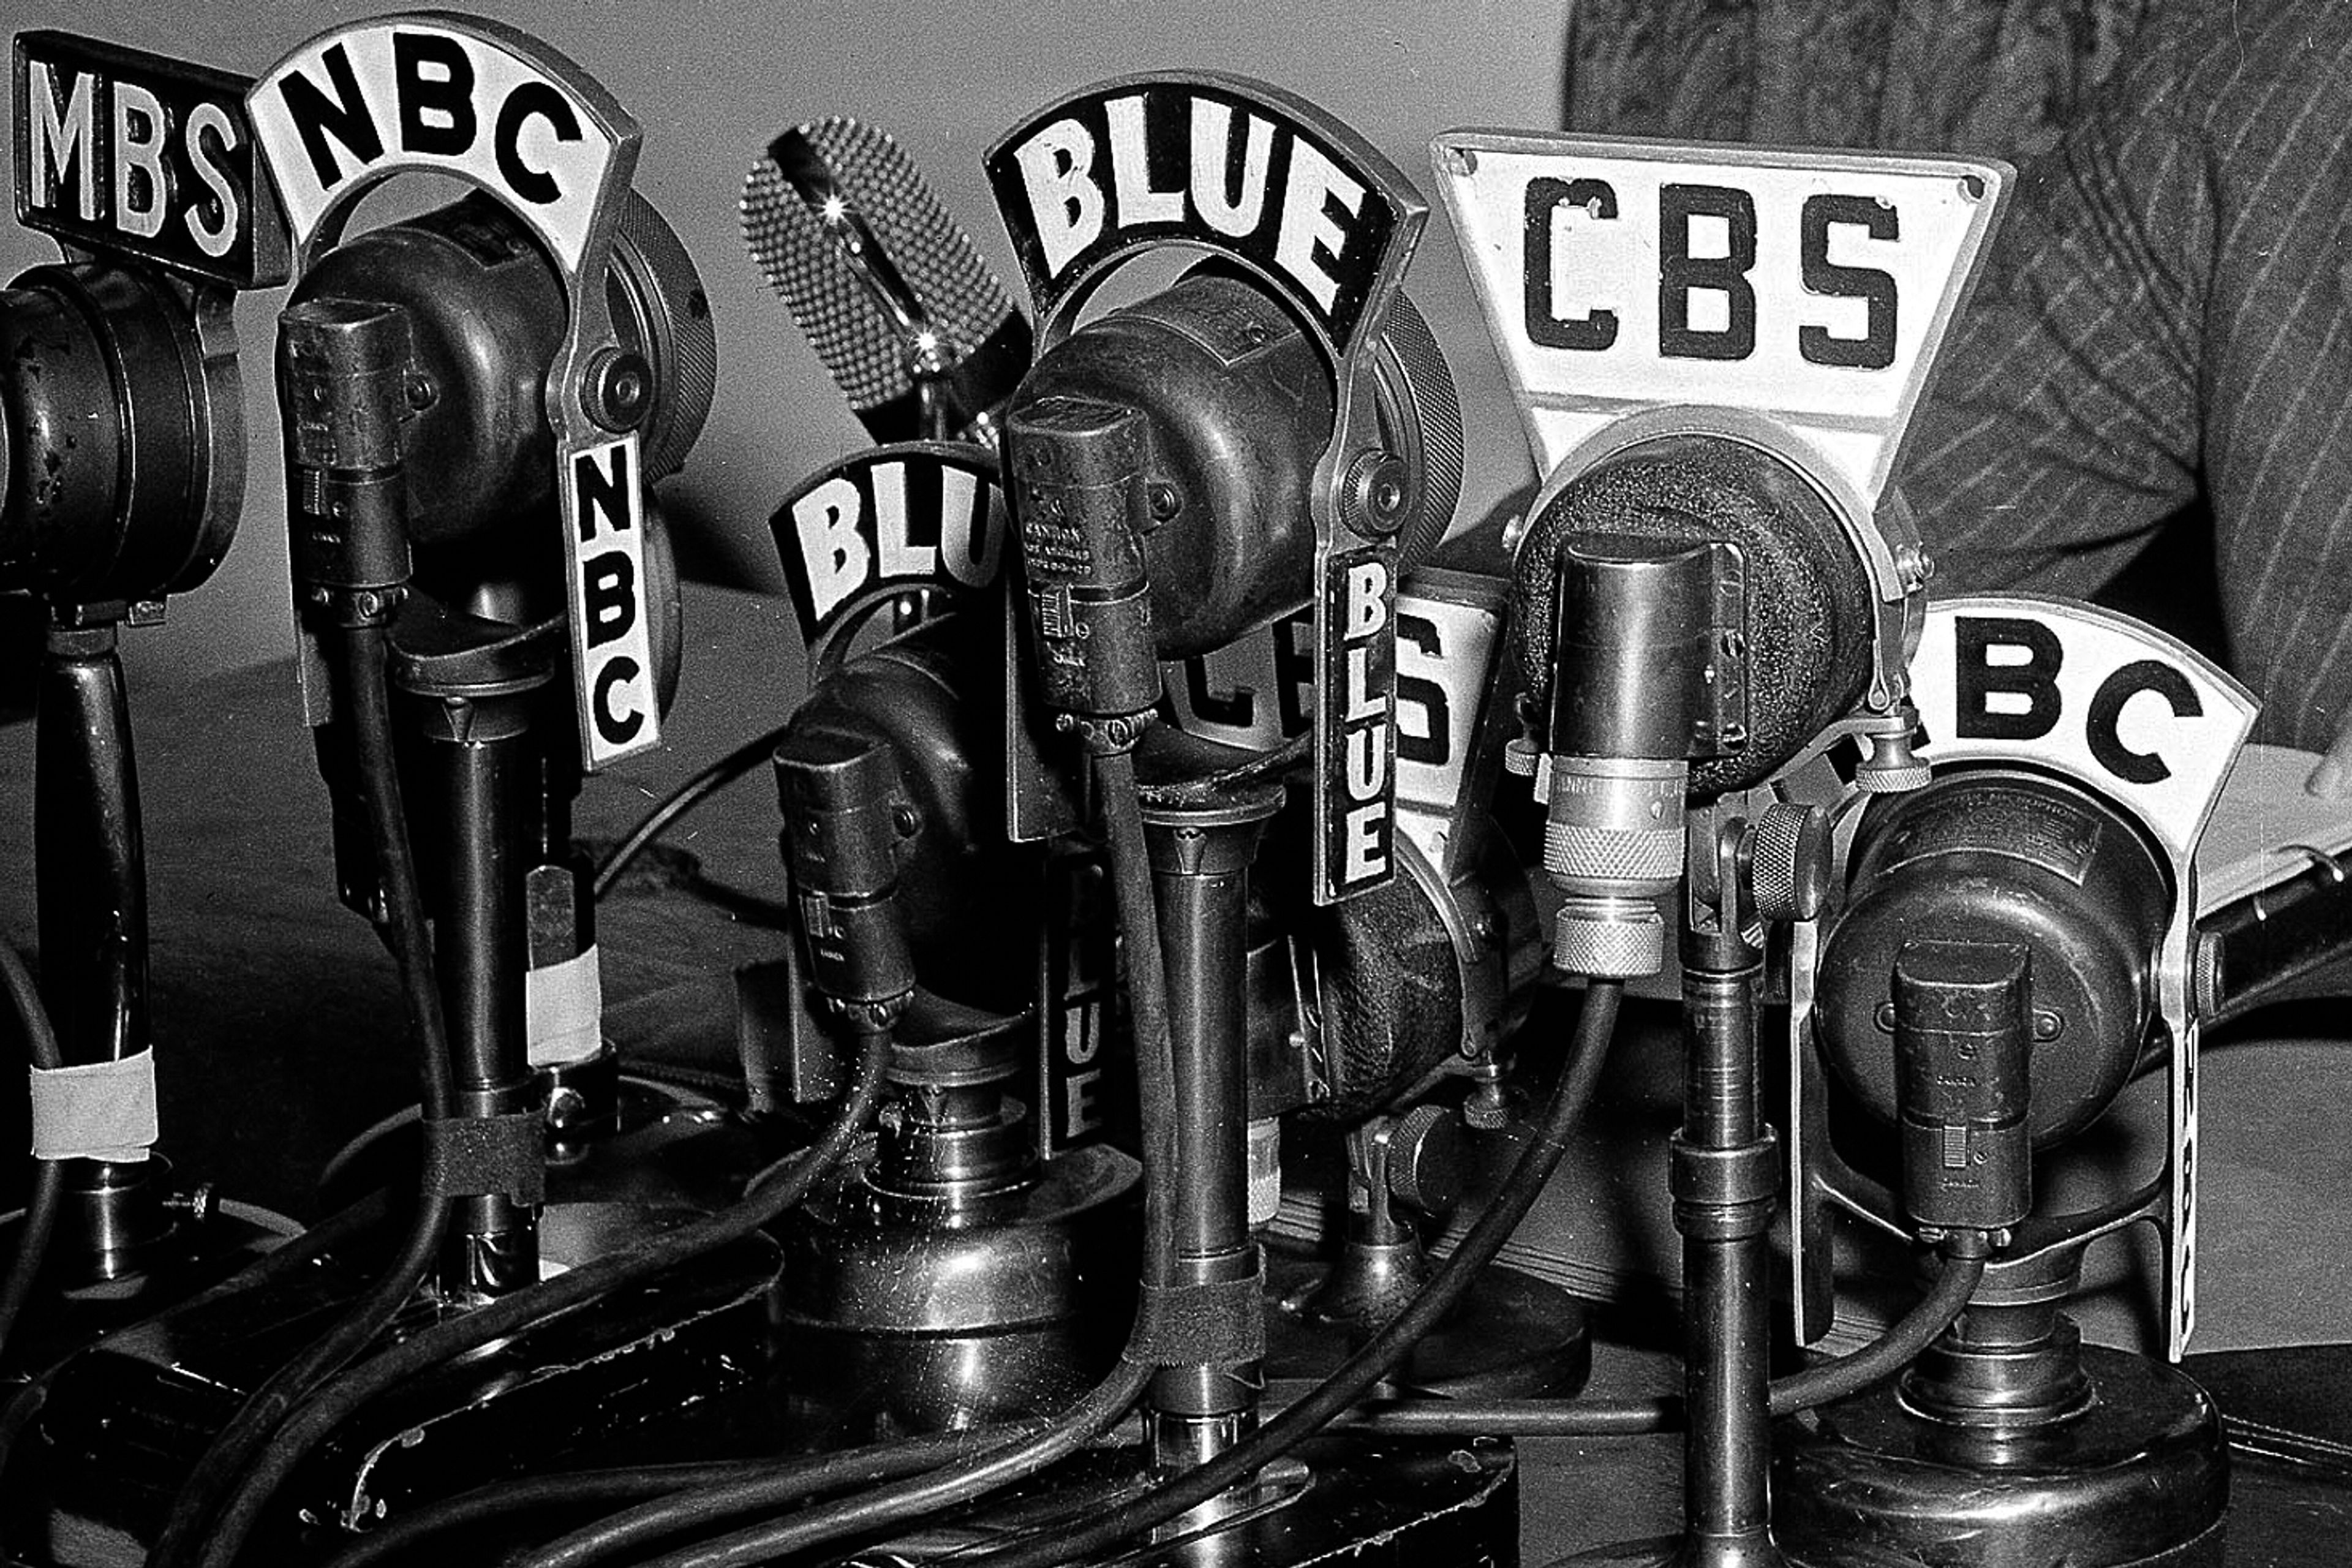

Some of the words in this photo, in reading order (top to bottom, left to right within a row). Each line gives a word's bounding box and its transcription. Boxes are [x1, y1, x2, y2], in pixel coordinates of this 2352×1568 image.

[28, 59, 238, 257] MBS
[277, 32, 583, 204] NBC
[1014, 91, 1367, 317] BLUE
[1523, 176, 1900, 370] CBS
[575, 443, 645, 745] NBC
[792, 461, 1006, 622] BLU
[1343, 562, 1389, 884] BLUE
